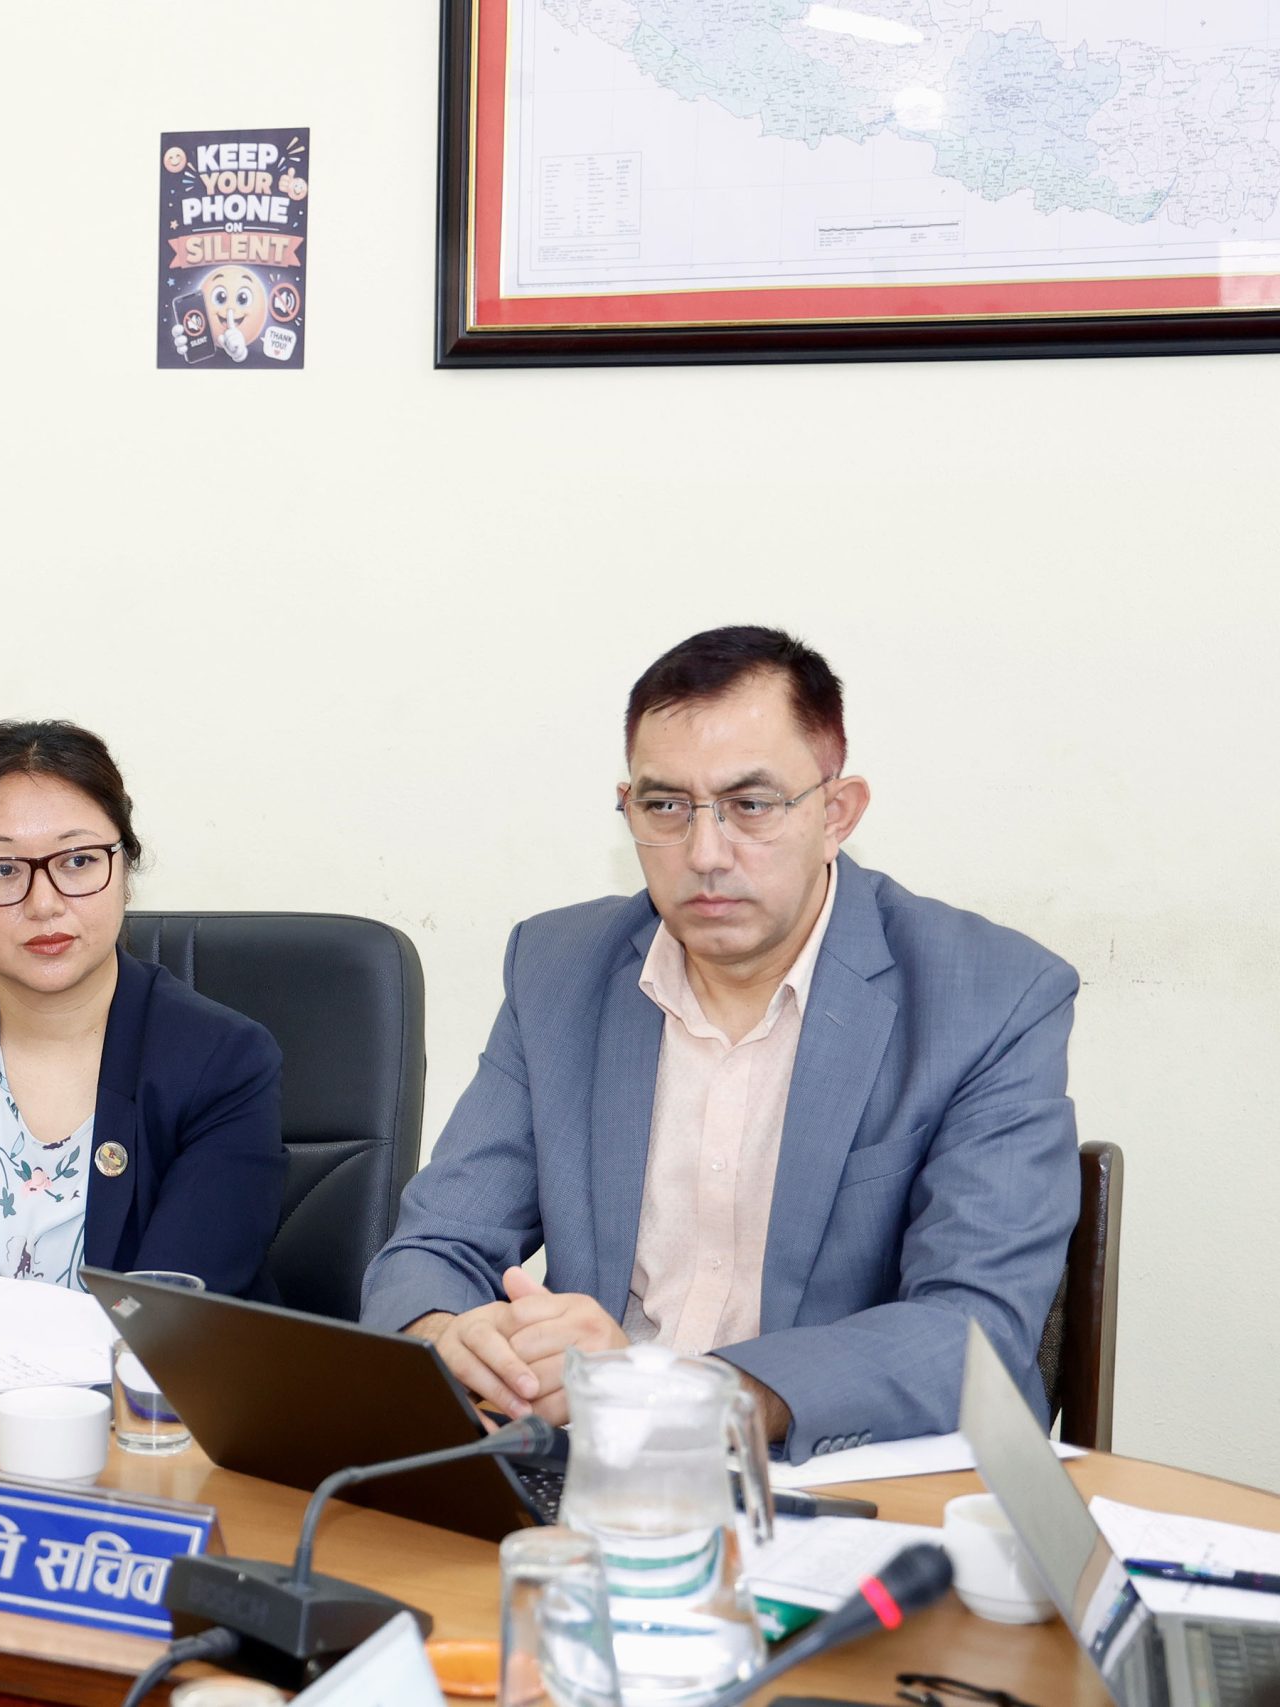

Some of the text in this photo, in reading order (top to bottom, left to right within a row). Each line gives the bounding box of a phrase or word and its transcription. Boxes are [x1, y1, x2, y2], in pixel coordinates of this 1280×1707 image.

[197, 143, 279, 172] KEEP
[199, 171, 273, 195] YOUR
[182, 194, 291, 225] PHONE
[225, 222, 243, 233] ON
[185, 234, 289, 264] SILENT
[269, 330, 293, 343] THANK
[34, 1531, 173, 1605] सचिव
